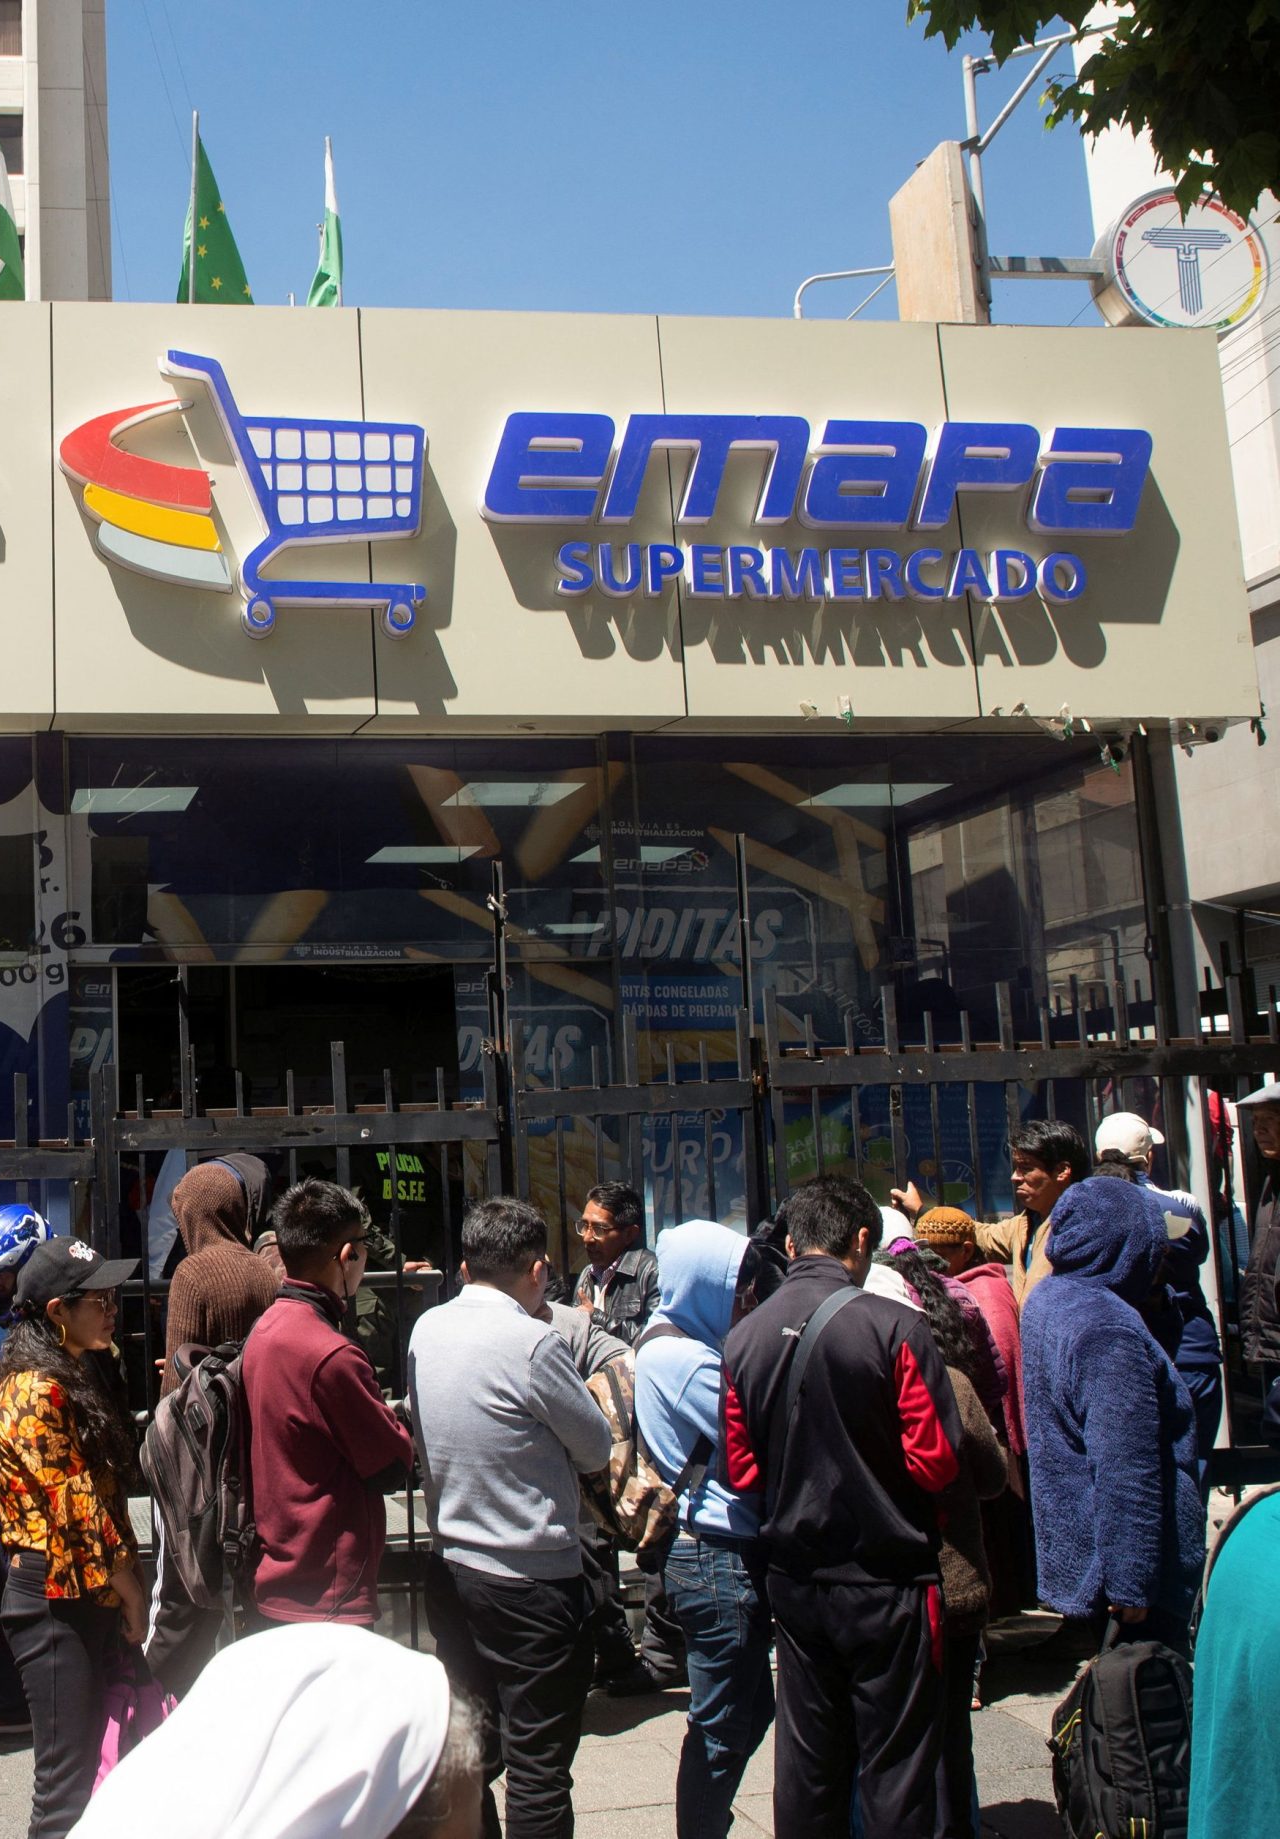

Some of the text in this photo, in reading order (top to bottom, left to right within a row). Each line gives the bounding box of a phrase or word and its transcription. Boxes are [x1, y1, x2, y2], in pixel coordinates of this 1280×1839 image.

[479, 412, 1153, 535] emapa
[555, 541, 1087, 605] SUPERMERCADO
[620, 985, 729, 998] RITAS CONGELADAS
[671, 1004, 686, 1017] DE
[689, 1004, 739, 1017] PREPARA
[376, 1151, 425, 1174] PLICIA
[786, 1142, 849, 1169] ATURAL
